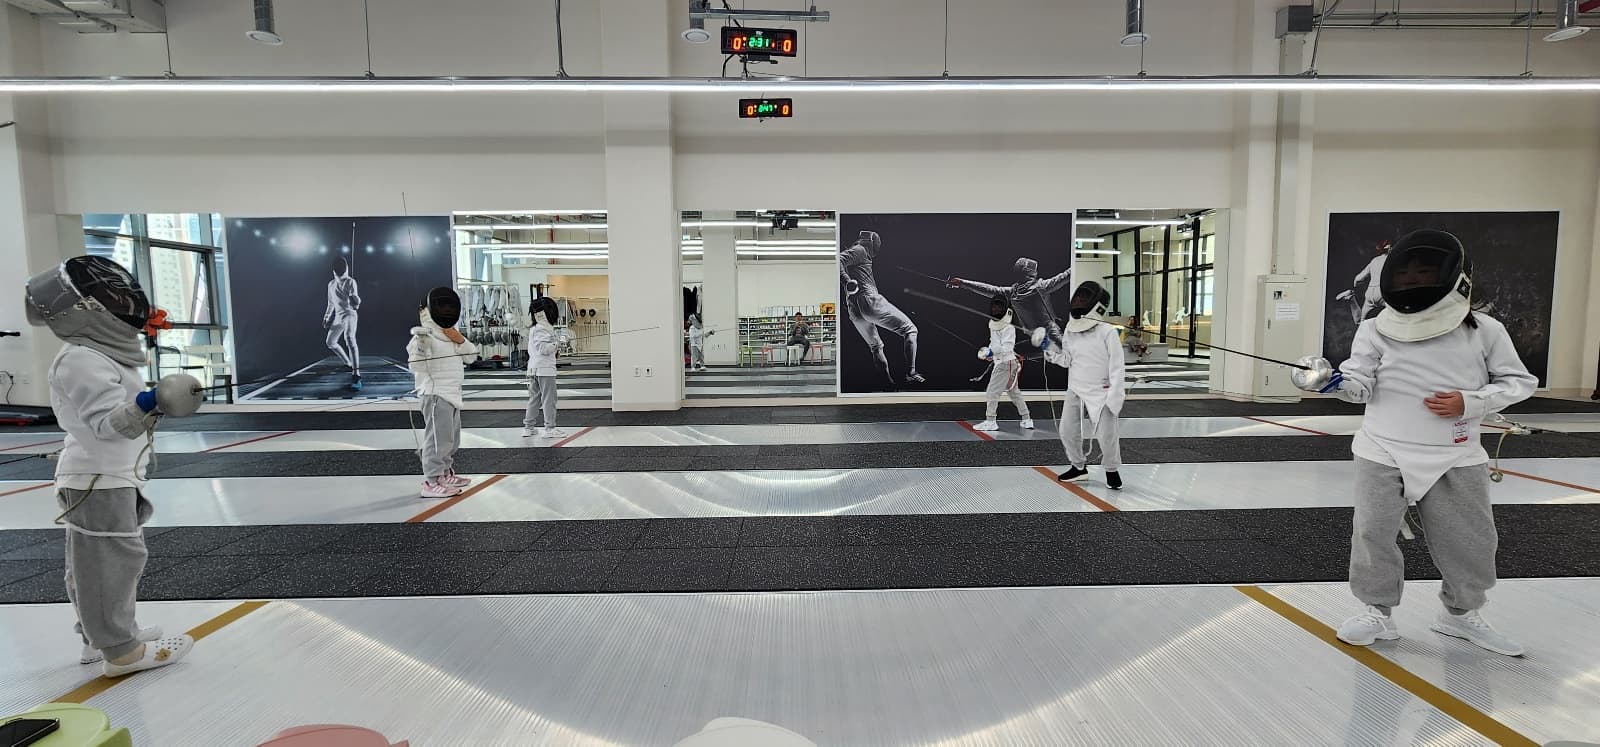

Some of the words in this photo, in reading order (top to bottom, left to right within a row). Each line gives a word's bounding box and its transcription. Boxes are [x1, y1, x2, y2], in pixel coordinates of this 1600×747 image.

[748, 37, 769, 47] 2:31
[783, 39, 792, 52] 0
[782, 105, 789, 115] 0
